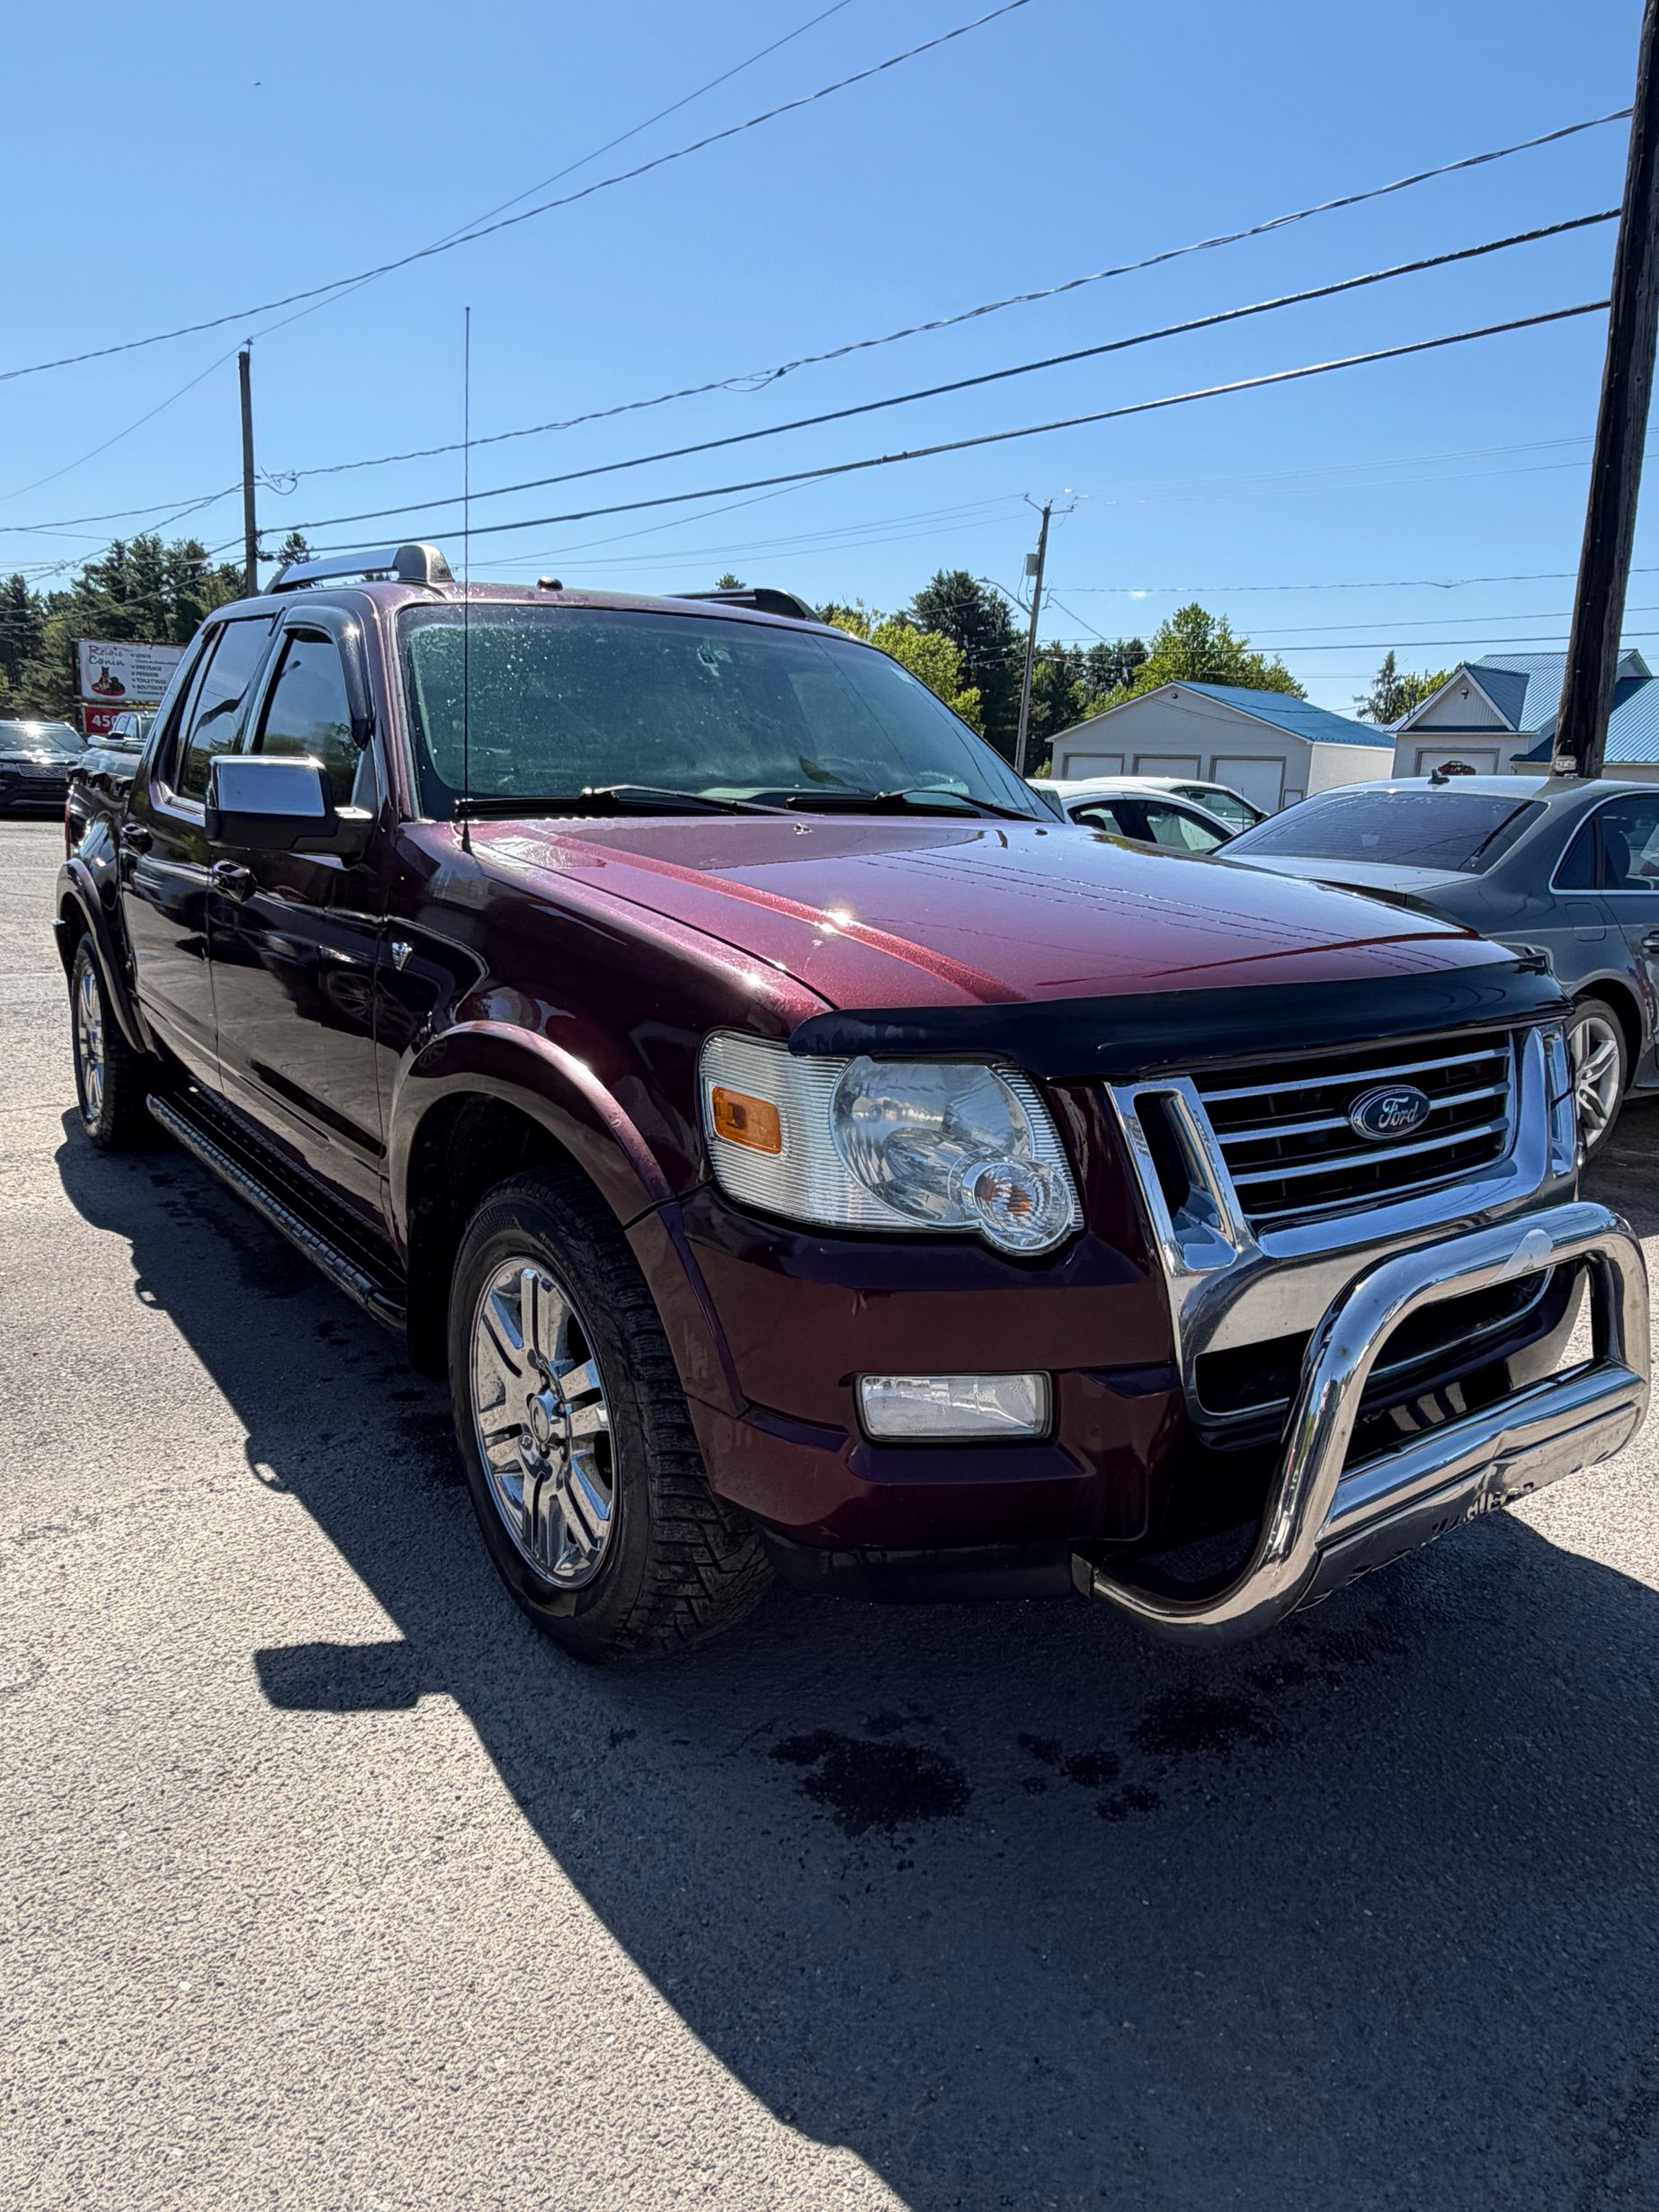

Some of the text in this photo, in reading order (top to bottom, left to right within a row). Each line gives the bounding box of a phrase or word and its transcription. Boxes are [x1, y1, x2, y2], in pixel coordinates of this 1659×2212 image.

[88, 646, 123, 656] Relais
[89, 656, 125, 666] Canin
[1378, 1096, 1419, 1128] Ford
